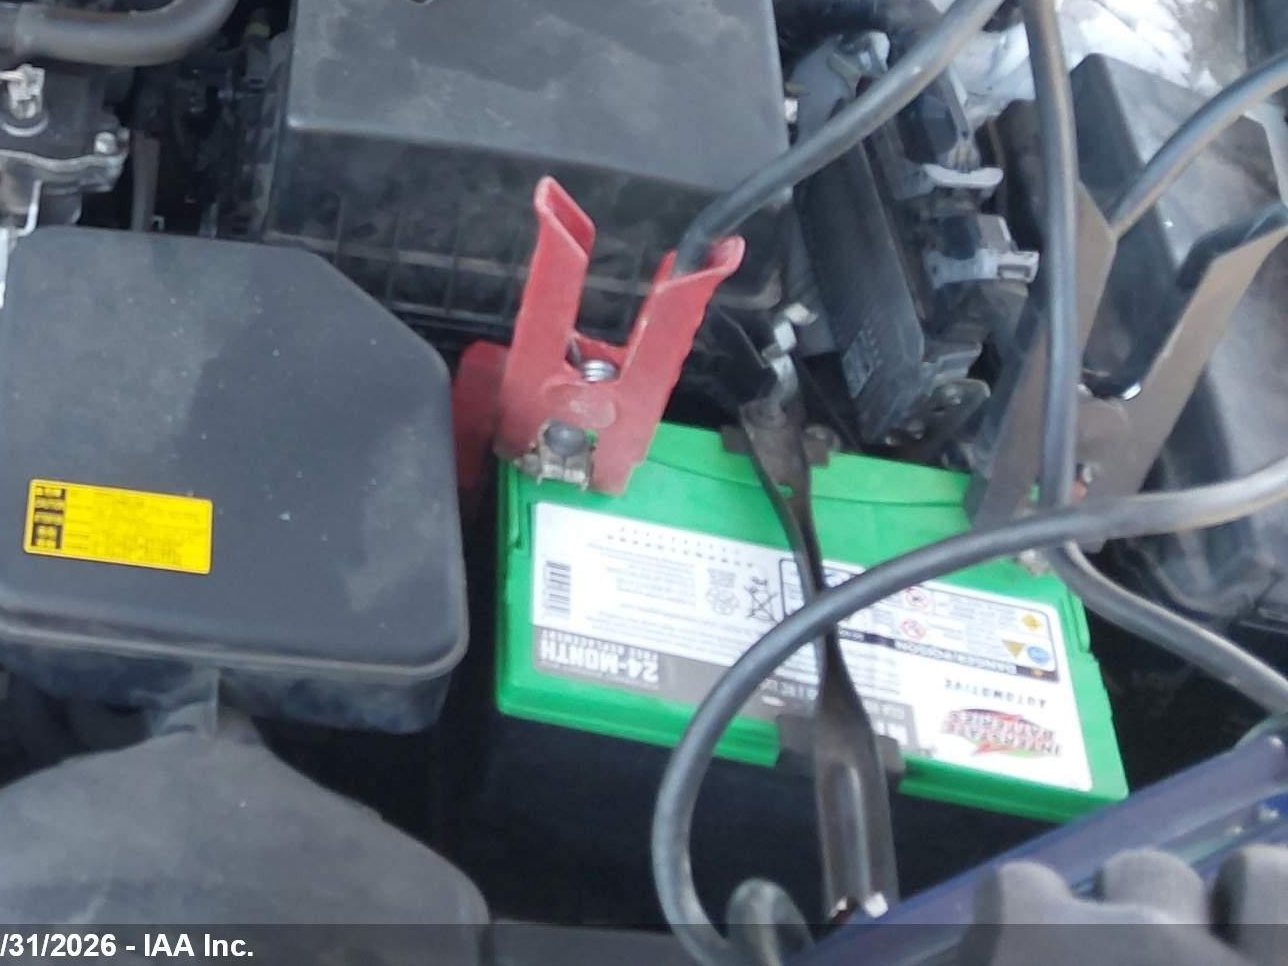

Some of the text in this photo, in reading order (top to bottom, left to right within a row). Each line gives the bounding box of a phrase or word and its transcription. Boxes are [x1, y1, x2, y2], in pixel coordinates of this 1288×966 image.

[541, 640, 659, 682] 24-MONTH
[943, 679, 1047, 709] AUTOMOTIVE
[941, 721, 1062, 757] INTERSTATE
[950, 711, 1054, 743] BATTERIES
